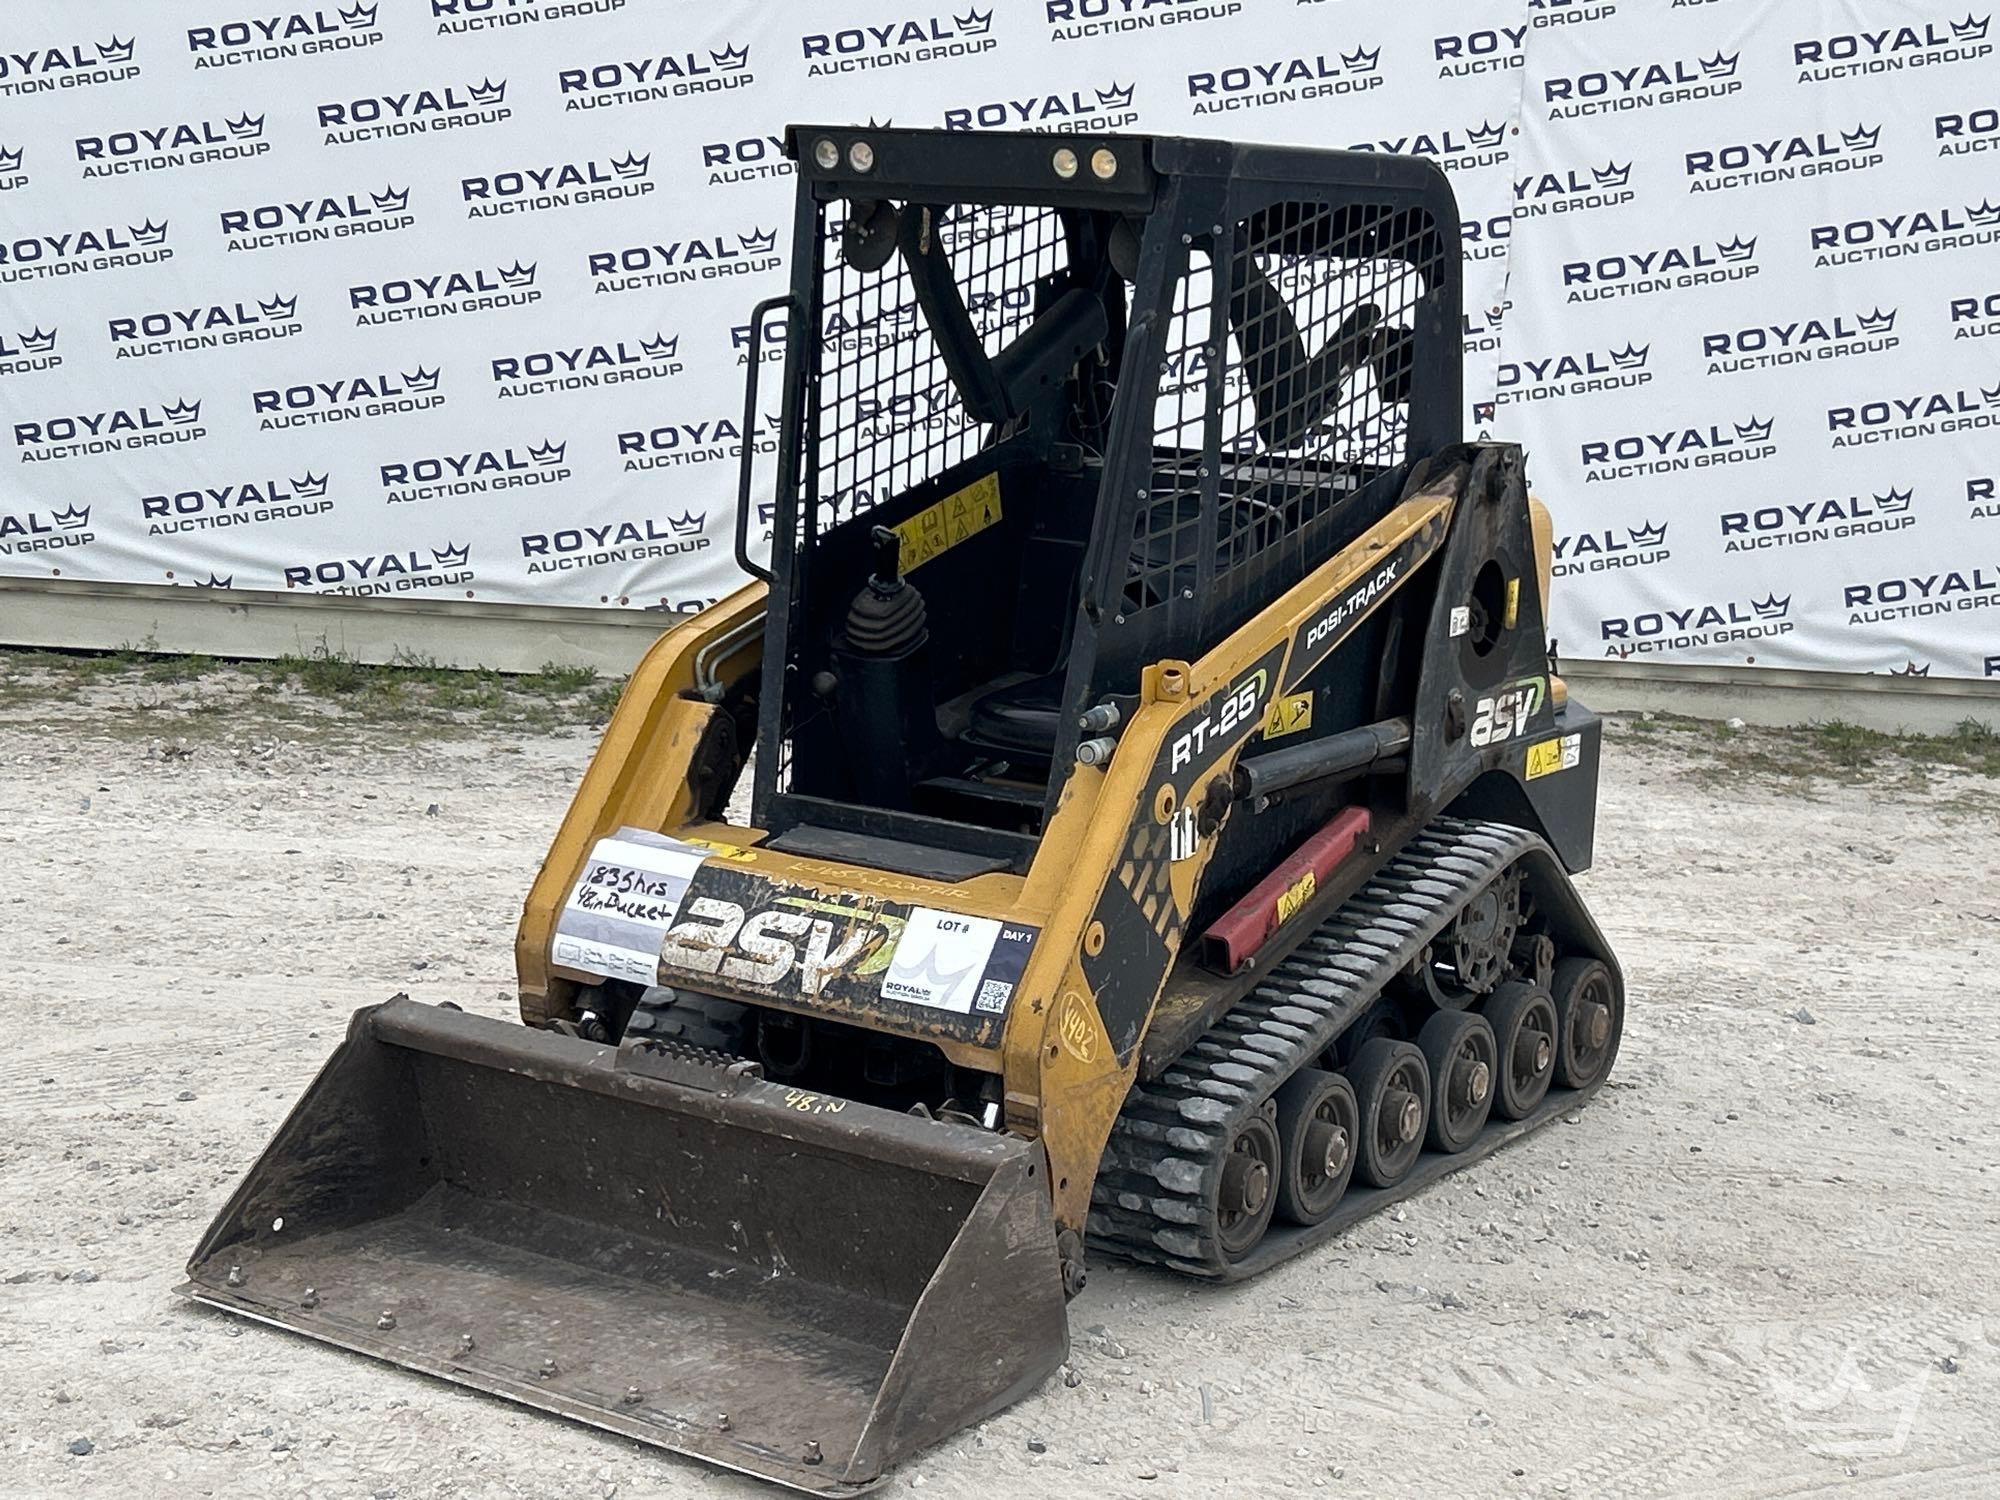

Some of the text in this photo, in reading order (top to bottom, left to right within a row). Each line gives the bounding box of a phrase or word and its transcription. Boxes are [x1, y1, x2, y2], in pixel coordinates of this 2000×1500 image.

[437, 9, 539, 35] AUCTION
[545, 0, 625, 19] GROUP
[1046, 0, 1198, 23] ROY
[1052, 3, 1241, 42] AUCTION GROUP
[1533, 6, 1616, 28] GROUP
[187, 12, 339, 51] ROYAL
[802, 18, 954, 59] ROYAL
[1434, 24, 1528, 60] ROY
[1794, 24, 1949, 65] ROYAL
[0, 46, 97, 78] YAL
[195, 32, 383, 69] AUCTION GROUP
[808, 39, 996, 77] AUCTION GROUP
[1439, 55, 1524, 79] AUCTIO
[1798, 45, 1993, 84] AUCTION GROUP
[0, 66, 140, 96] TION GROUP
[559, 53, 710, 94] ROYAL
[1188, 56, 1340, 97] ROYAL
[1544, 61, 1698, 102] ROYAL
[317, 88, 468, 127] ROYAL
[566, 74, 753, 112] AUCTION GROUP
[1193, 76, 1383, 115] AUCTION GROUP
[1549, 81, 1742, 121] AUCTION GROUP
[324, 109, 511, 145] AUCTION GROUP
[945, 92, 1095, 132] ROYAL
[1056, 113, 1139, 134] GROUP
[75, 122, 227, 161] ROYAL
[1686, 134, 1840, 175] ROYAL
[1939, 137, 2000, 157] AUCT
[83, 143, 270, 179] AUCTION GROUP
[1690, 154, 1883, 193] AUCTION GROUP
[462, 162, 612, 201] ROYAL
[1513, 171, 1591, 200] YAL
[220, 195, 371, 234] ROYAL
[468, 182, 654, 219] AUCTION GROUP
[1552, 191, 1634, 213] GROUP
[228, 216, 414, 252] AUCTION GROUP
[1811, 209, 1965, 250] ROYAL
[0, 249, 173, 282] UCTION GROUP
[589, 237, 739, 276] ROYAL
[1563, 245, 1716, 286] ROYAL
[1815, 242, 1919, 268] AUCTION
[349, 270, 499, 309] ROYAL
[595, 258, 781, 294] AUCTION GROUP
[1567, 266, 1759, 303] AUCTION GROUP
[109, 303, 259, 342] ROYAL
[356, 291, 541, 327] AUCTION GROUP
[116, 324, 302, 359] AUCTION GROUP
[1703, 317, 1856, 357] ROYAL
[0, 356, 62, 375] ROUP
[492, 343, 640, 381] ROYAL
[1497, 353, 1609, 387] OYAL
[1707, 337, 1899, 375] AUCTION GROUP
[253, 375, 403, 413] ROYAL
[498, 363, 683, 398] AUCTION GROUP
[1495, 373, 1652, 405] CTION GROUP
[14, 408, 163, 446] ROYAL
[260, 396, 445, 431] AUCTION GROUP
[1828, 391, 1980, 431] ROYAL
[21, 428, 206, 463] AUCTION GROUP
[1582, 426, 1733, 465] ROYAL
[1832, 423, 1935, 448] AUCTION
[380, 449, 528, 486] ROYAL
[624, 448, 724, 472] AUCTION
[1586, 446, 1776, 483] AUCTION GROUP
[142, 481, 291, 519] ROYAL
[387, 469, 571, 504] AUCTION GROUP
[149, 501, 333, 536] AUCTION GROUP
[1721, 497, 1873, 536] ROYAL
[1725, 516, 1915, 553] AUCTION GROUP
[17, 533, 95, 553] GROUP
[521, 520, 668, 557] ROYAL
[528, 538, 710, 574] AUCTION GROUP
[1552, 531, 1627, 559] YAL
[284, 551, 432, 588] ROYAL
[1590, 550, 1670, 571] GROUP
[396, 571, 475, 591] GROUP
[1844, 569, 1996, 608] ROYAL
[1305, 561, 1398, 650] POSI-TRACK
[1601, 603, 1751, 640] ROYAL
[1849, 594, 2000, 625] AUCTION GRO
[1605, 622, 1793, 659] AUCTION GROUP
[1171, 680, 1257, 775] RT-25
[936, 919, 961, 932] LOT
[1002, 929, 1033, 943] DAY 1
[886, 982, 922, 996] ROYAL
